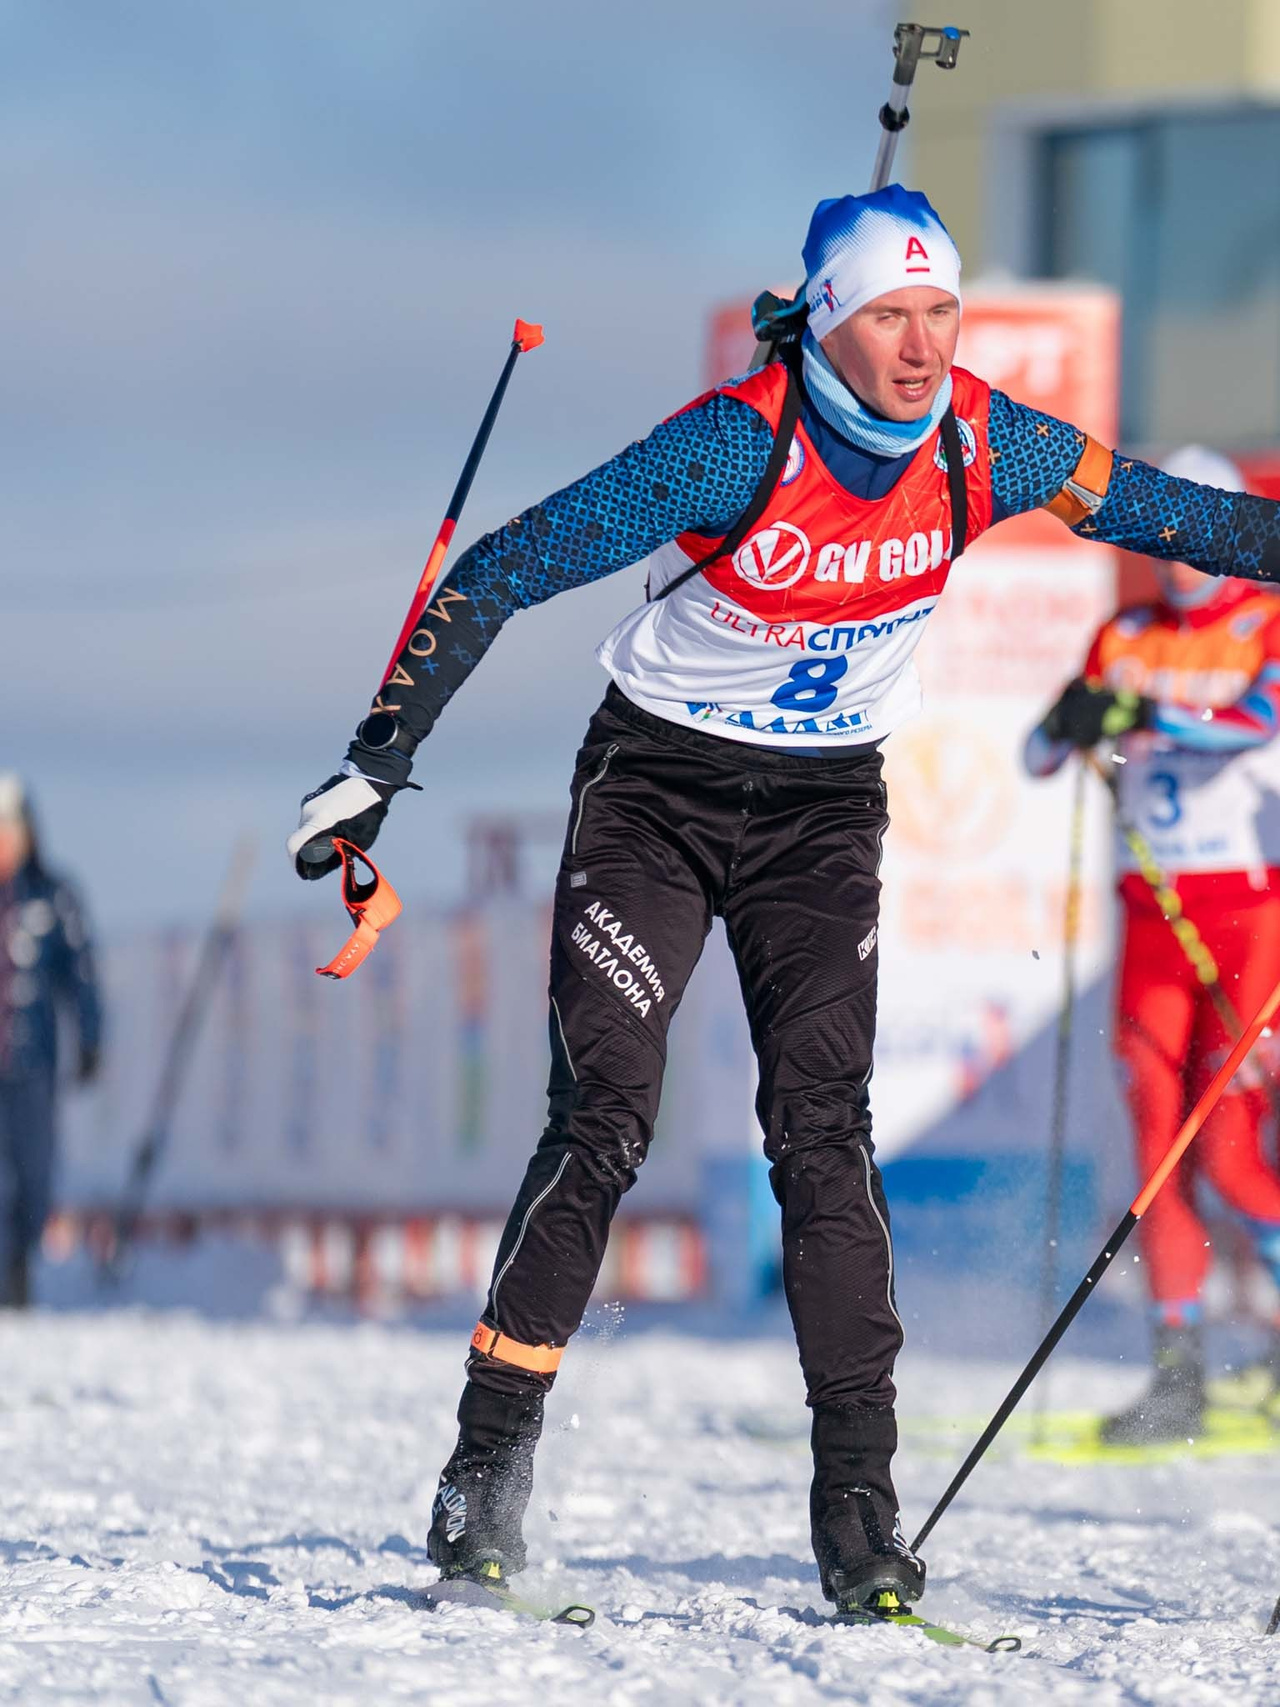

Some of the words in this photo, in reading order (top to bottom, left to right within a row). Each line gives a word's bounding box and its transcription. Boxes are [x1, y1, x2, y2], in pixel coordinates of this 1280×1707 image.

[815, 540, 871, 583] GV
[879, 529, 953, 582] GOL
[769, 654, 848, 713] 8
[1145, 769, 1184, 830] 3
[571, 922, 652, 1019] БИАТЛОНА
[584, 901, 666, 1003] АКАДЕМИЯ
